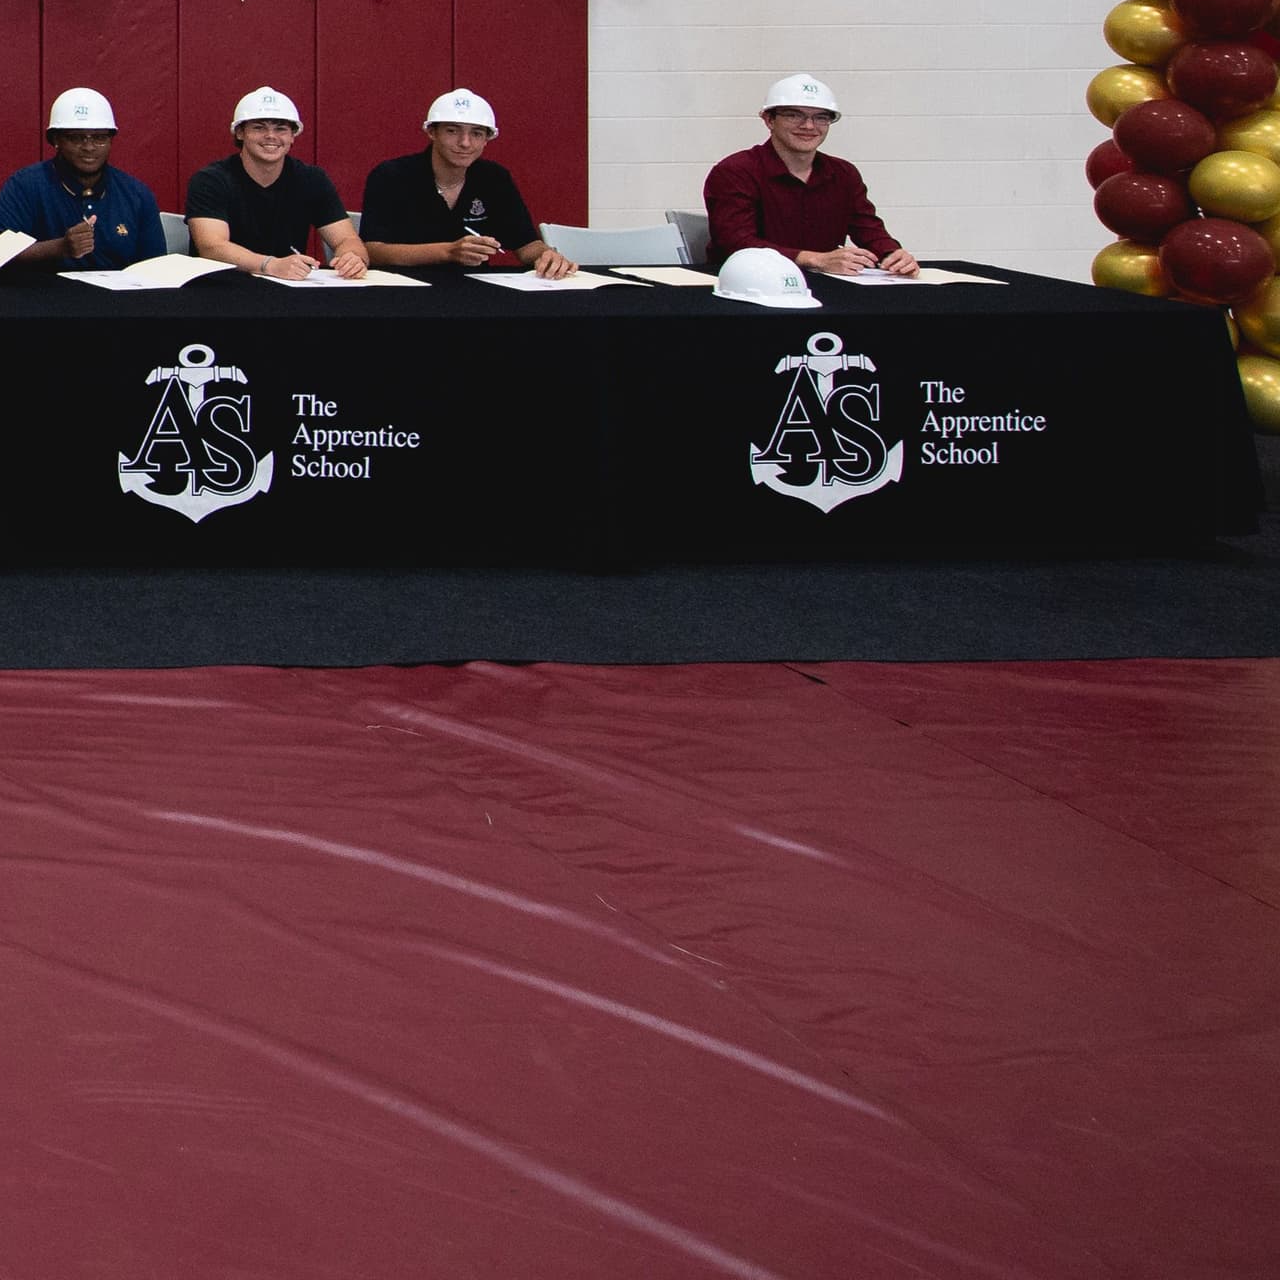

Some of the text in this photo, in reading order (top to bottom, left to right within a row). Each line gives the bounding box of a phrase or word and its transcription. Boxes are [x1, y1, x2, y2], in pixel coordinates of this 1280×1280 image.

[291, 393, 338, 417] The
[919, 380, 965, 404] The
[120, 374, 257, 496] AS
[291, 422, 420, 452] Apprentice
[753, 363, 888, 486] AS
[920, 408, 1047, 439] Apprentice
[291, 454, 370, 479] School
[920, 441, 999, 465] School
